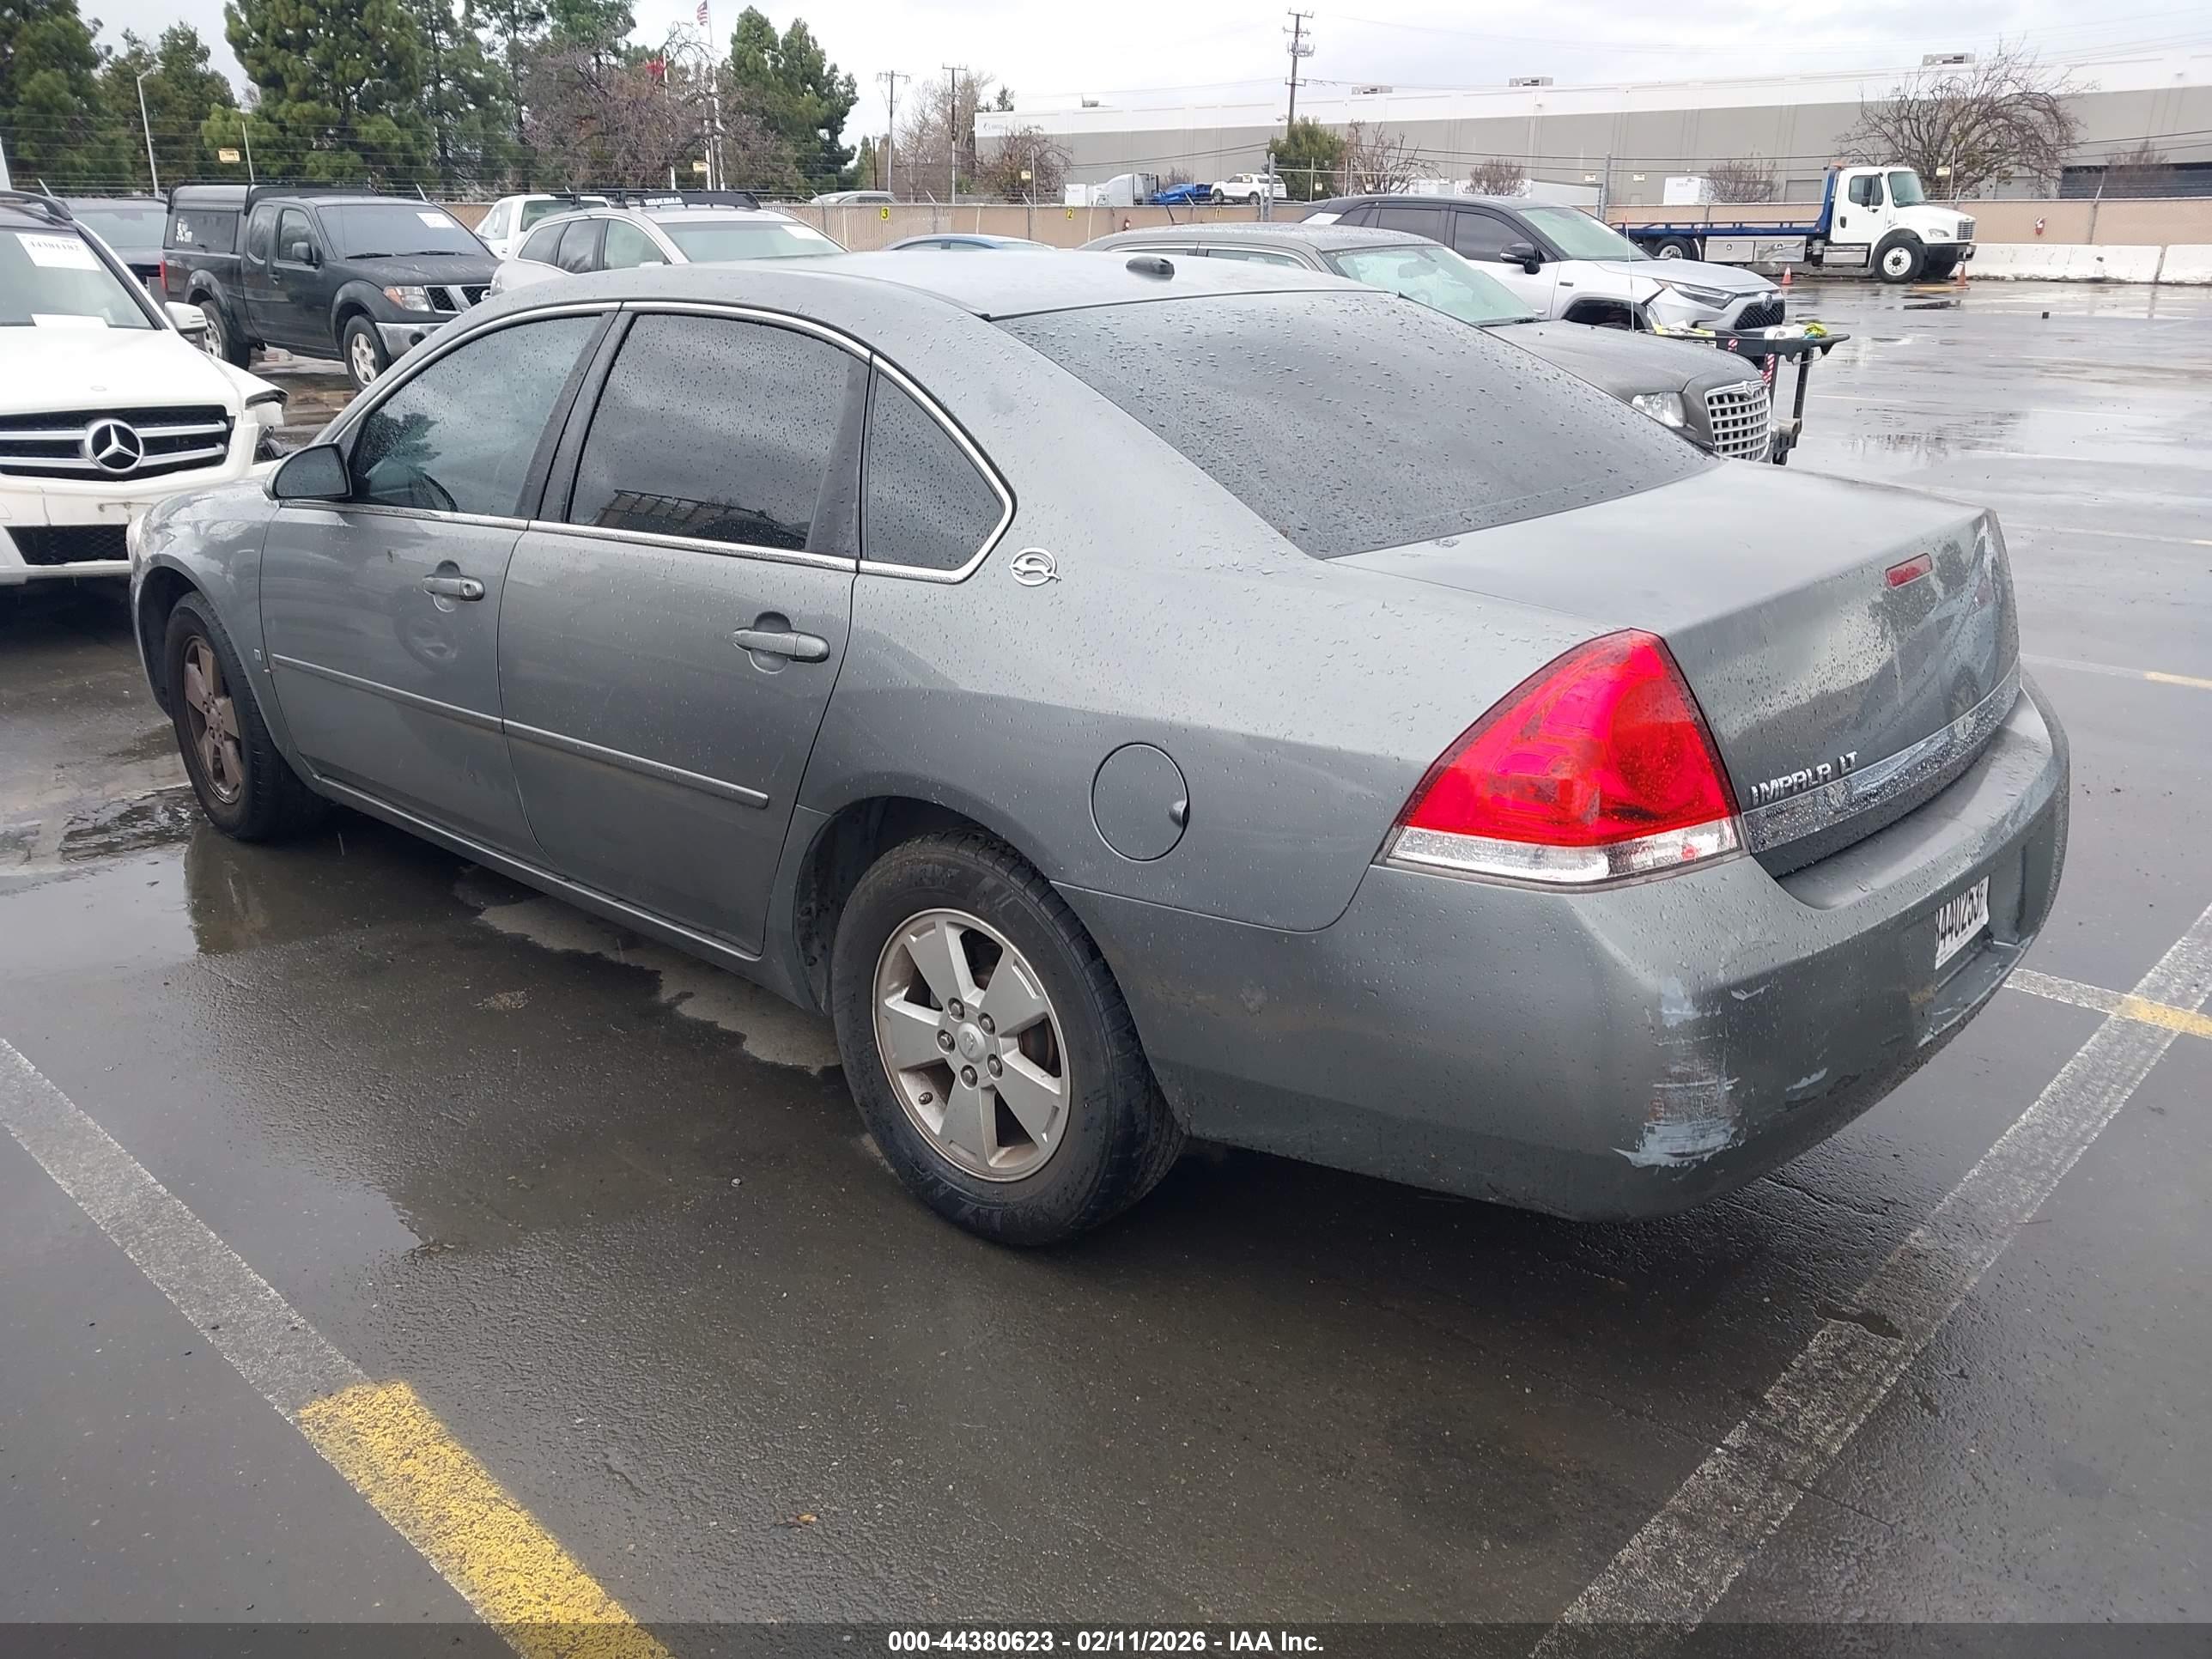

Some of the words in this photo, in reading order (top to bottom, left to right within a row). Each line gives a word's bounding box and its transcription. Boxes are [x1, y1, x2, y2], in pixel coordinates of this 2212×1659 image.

[882, 208, 889, 220] 3
[1067, 209, 1073, 219] 2
[1750, 762, 1832, 807] IMPALA
[1838, 750, 1858, 775] LT
